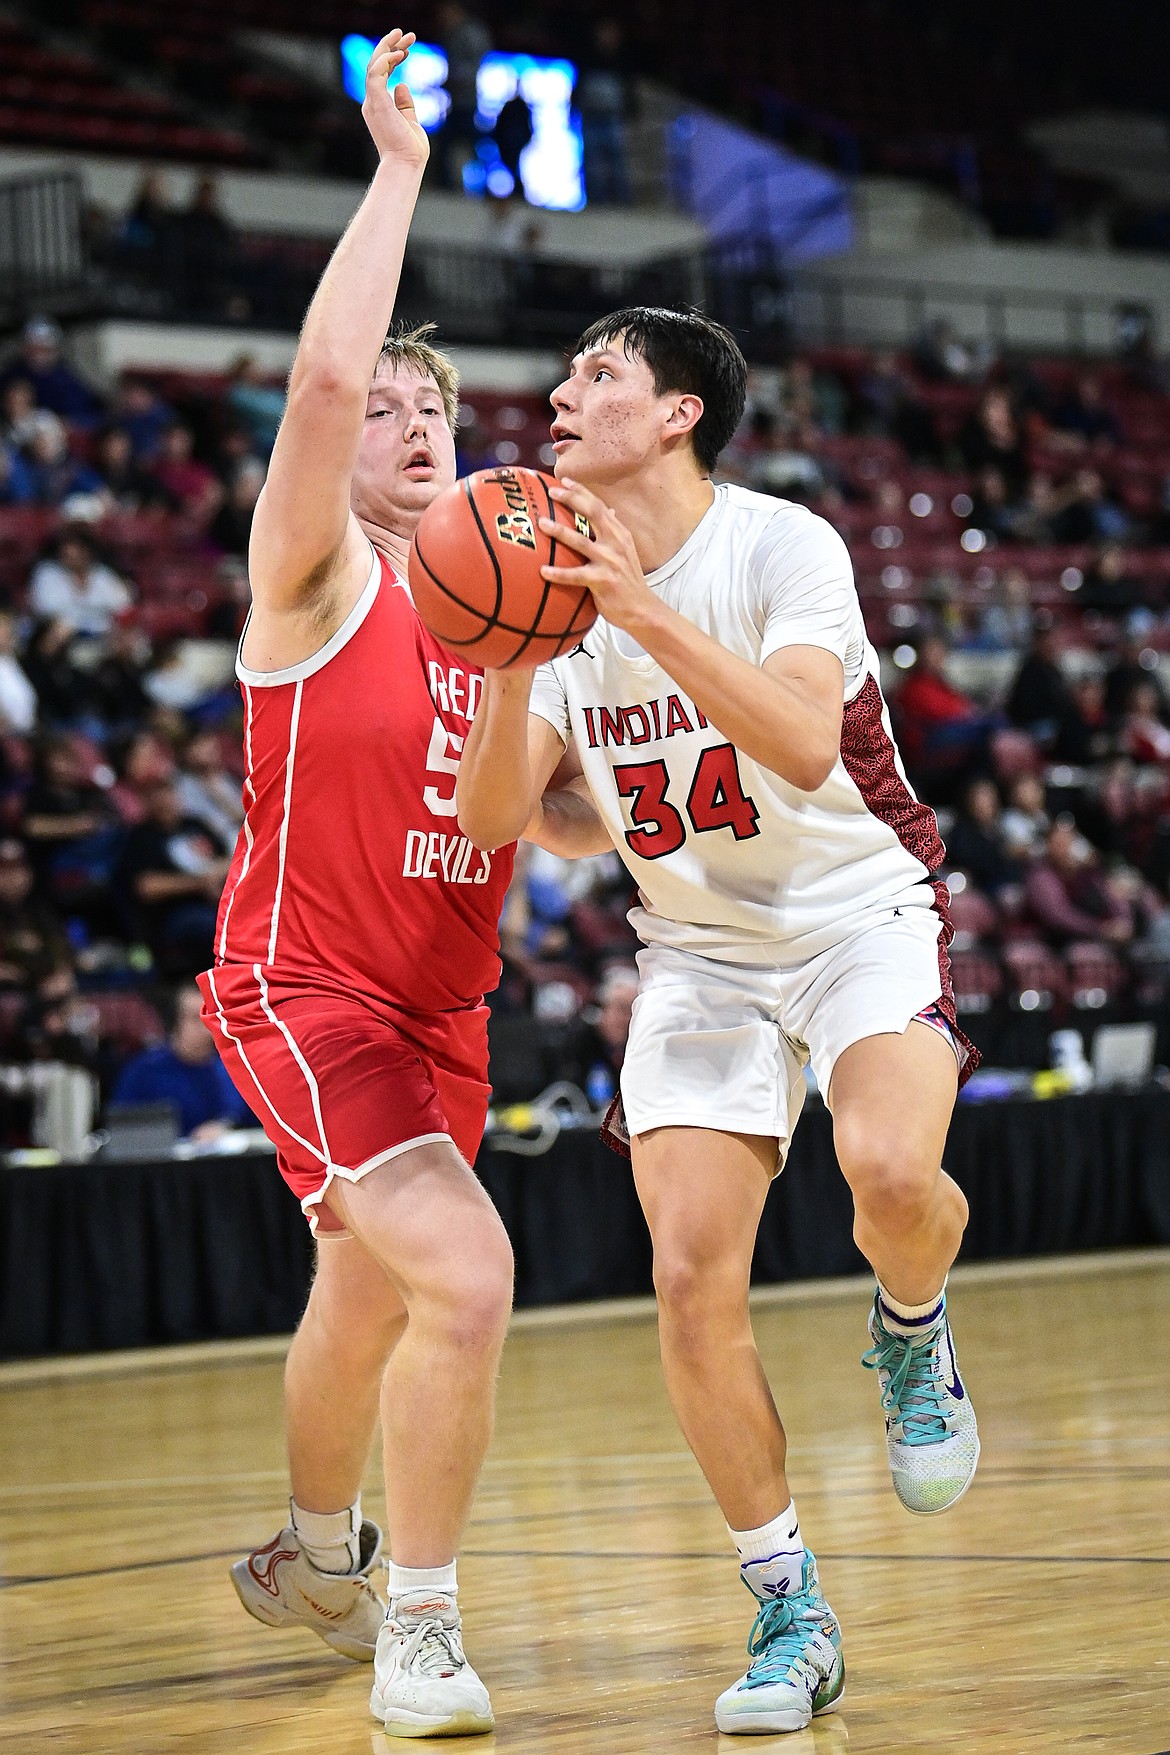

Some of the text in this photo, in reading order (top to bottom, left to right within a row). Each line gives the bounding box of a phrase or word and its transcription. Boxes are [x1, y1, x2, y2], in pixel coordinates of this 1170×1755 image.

[428, 660, 485, 721] RED
[581, 694, 708, 748] INDIA
[422, 716, 465, 817] 5
[612, 742, 761, 860] 34
[402, 829, 496, 884] DEVILS
